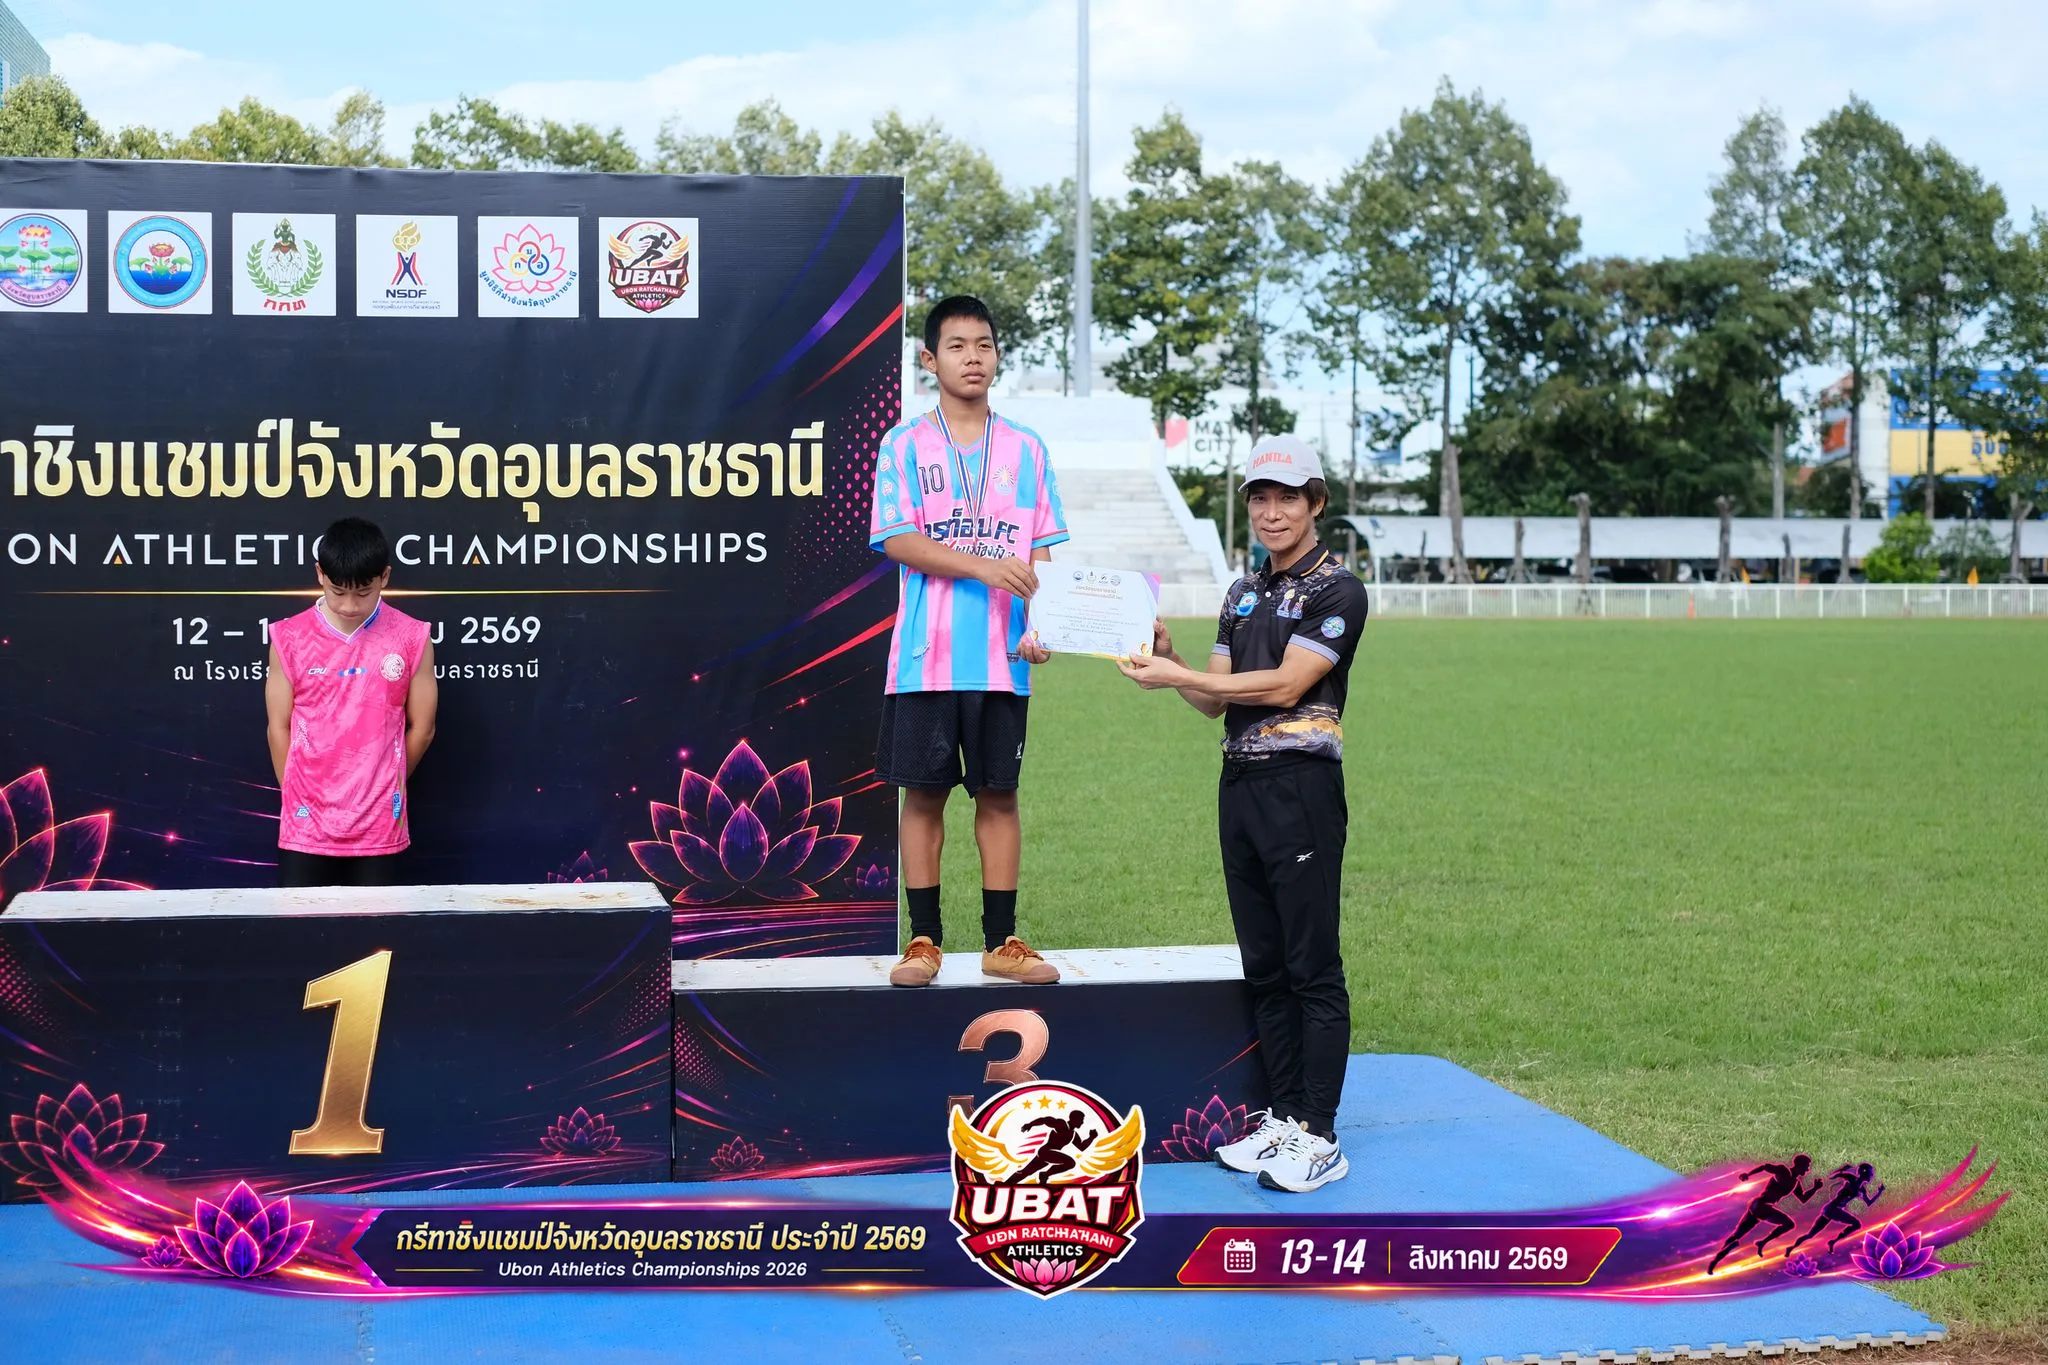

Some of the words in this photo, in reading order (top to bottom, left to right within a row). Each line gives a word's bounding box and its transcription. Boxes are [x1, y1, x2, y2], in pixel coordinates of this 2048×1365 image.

[615, 269, 684, 286] UBAT
[386, 289, 427, 298] NSDF
[263, 299, 306, 311] กกท
[1252, 453, 1292, 469] MANILA
[919, 463, 945, 495] 10
[993, 520, 1020, 545] FC
[102, 533, 325, 566] ATHLETI
[395, 531, 768, 566] CHAMPIONSHIPS
[172, 617, 208, 645] 12
[460, 615, 541, 644] 2569
[174, 665, 194, 680] ณ
[288, 950, 393, 1155] 1
